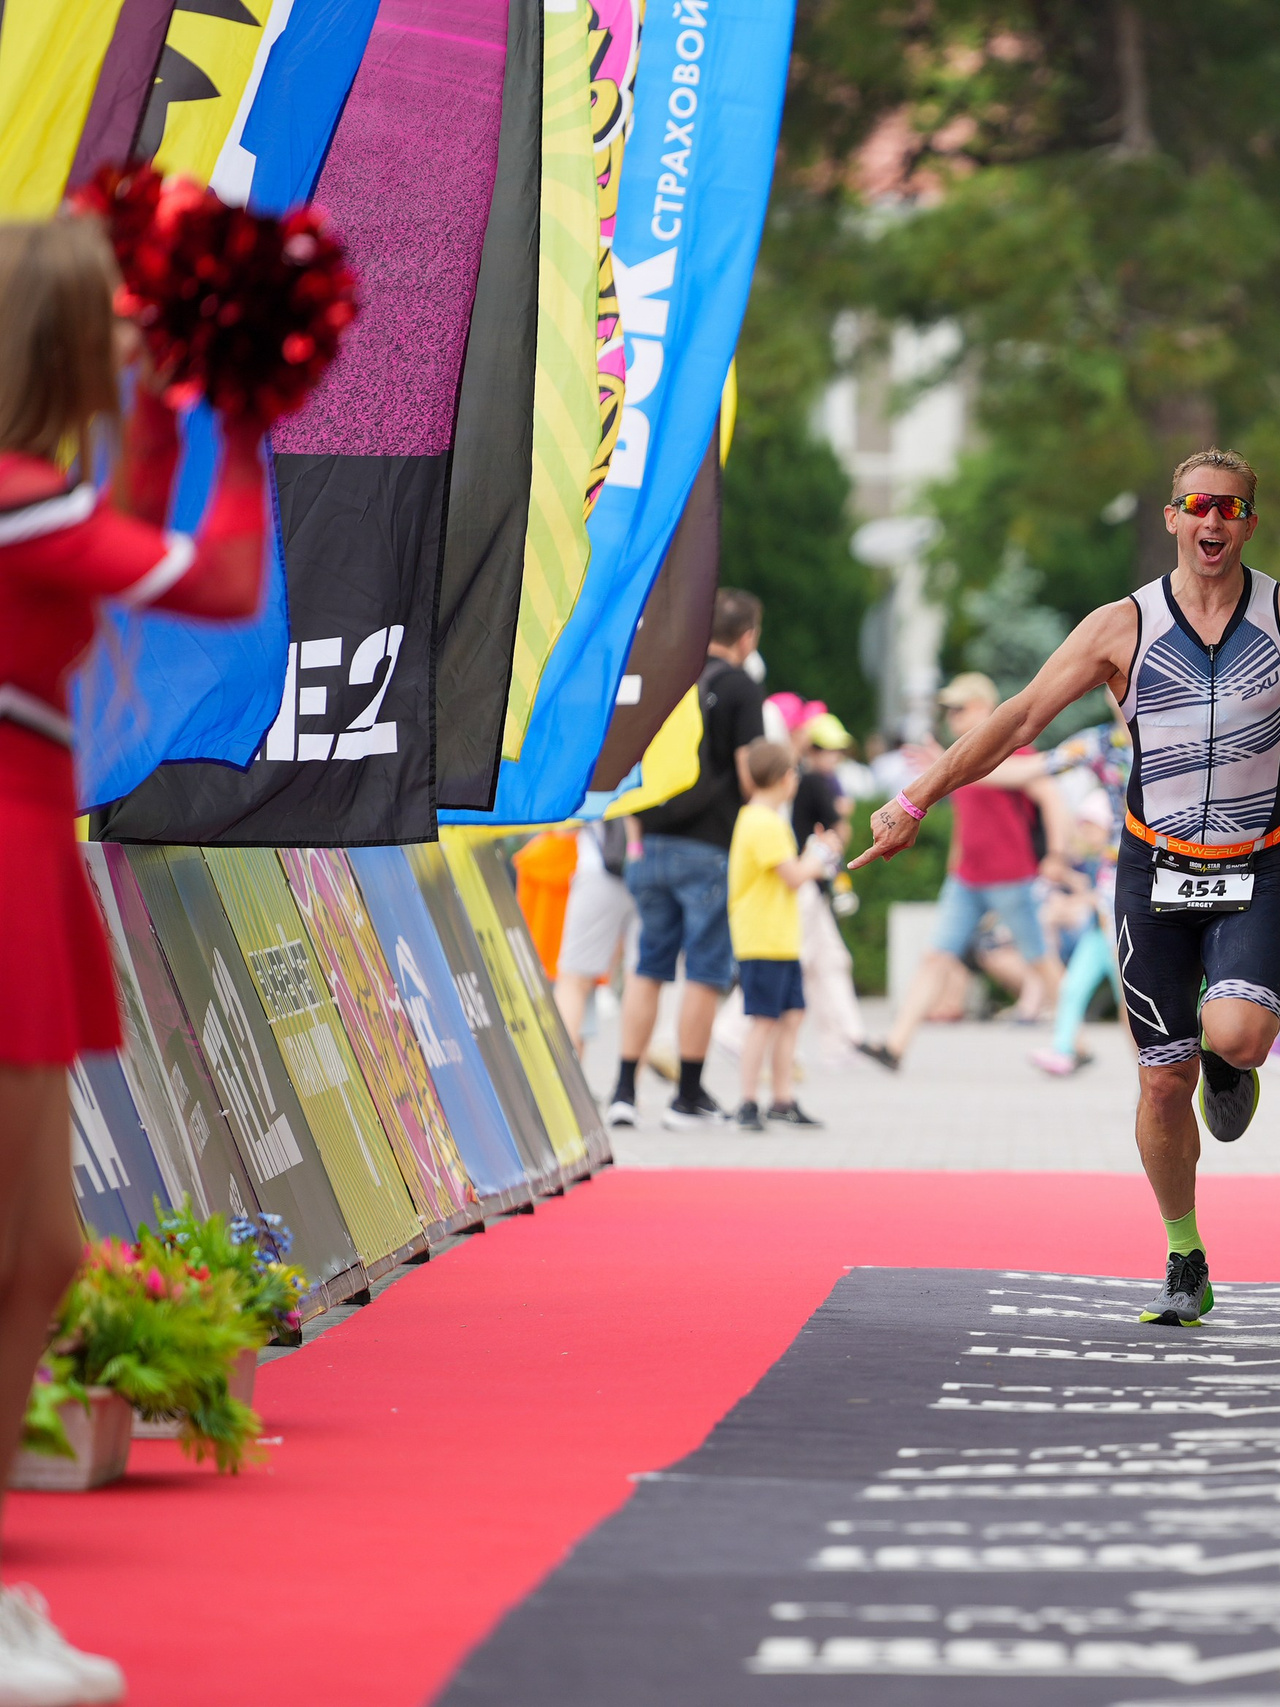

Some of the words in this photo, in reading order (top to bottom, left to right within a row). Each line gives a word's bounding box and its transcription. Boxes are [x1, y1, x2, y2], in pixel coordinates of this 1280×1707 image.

[651, 0, 709, 241] СТРАХОВОЙ
[1242, 671, 1279, 701] 2XU
[880, 811, 896, 829] 454
[1167, 840, 1253, 856] POWERUP
[1189, 861, 1202, 869] IRON
[1178, 879, 1226, 898] 454
[203, 947, 304, 1185] TELE2
